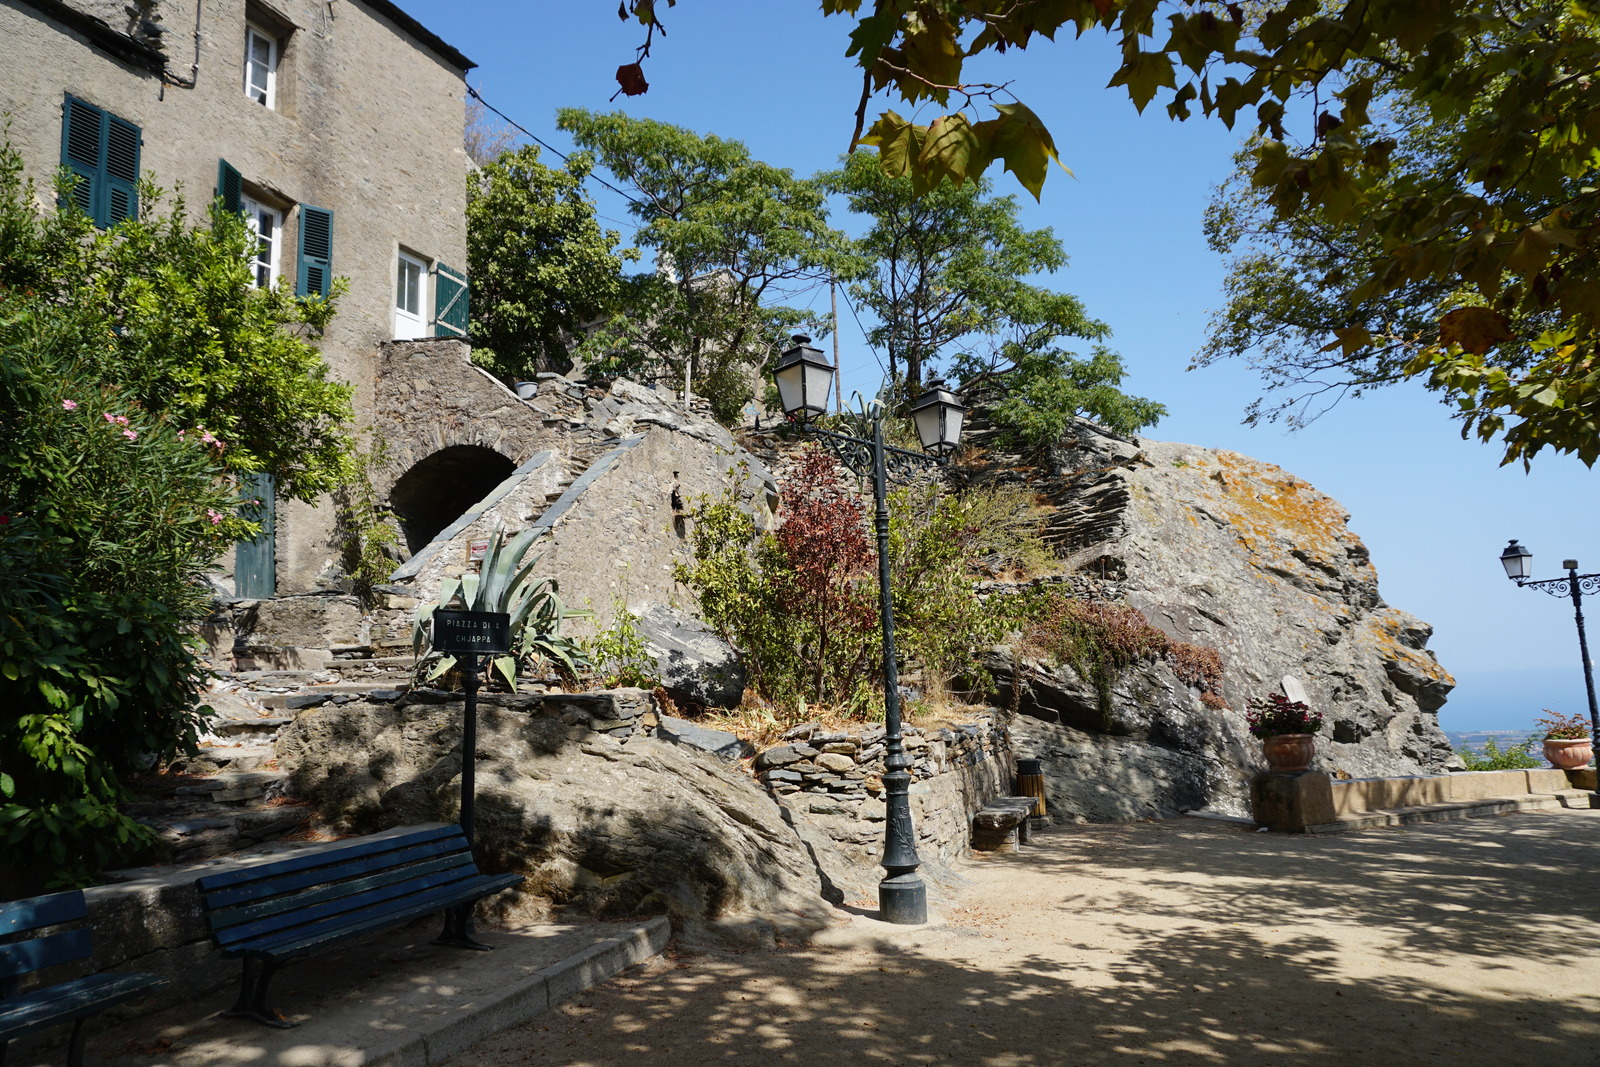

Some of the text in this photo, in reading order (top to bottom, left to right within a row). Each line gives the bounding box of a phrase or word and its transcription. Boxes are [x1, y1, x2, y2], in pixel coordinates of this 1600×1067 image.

[446, 619, 478, 629] PIAZZA
[482, 621, 491, 629] DI
[455, 635, 491, 643] CHJAPPA
